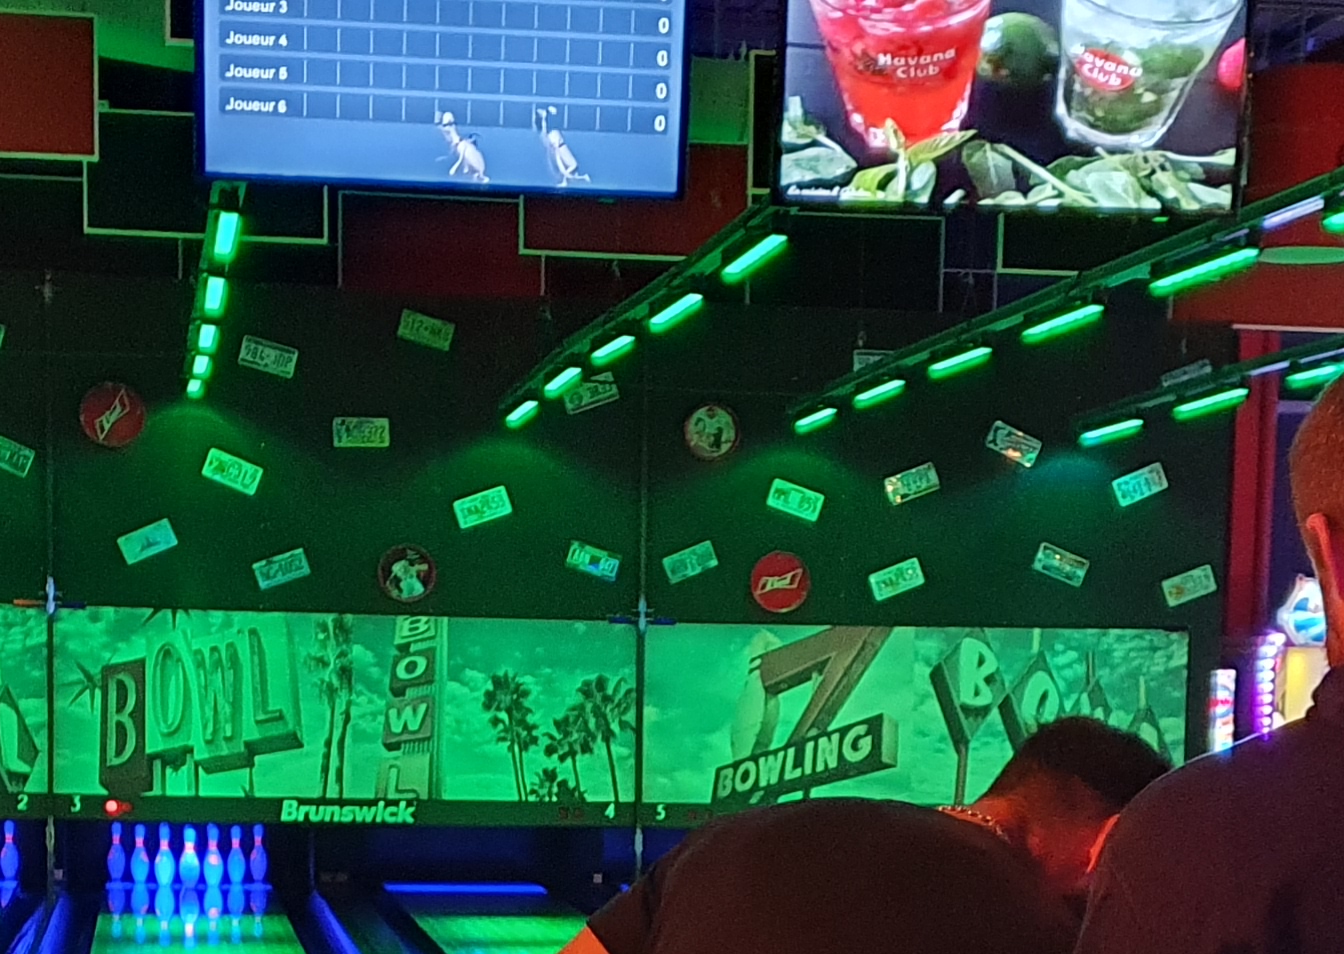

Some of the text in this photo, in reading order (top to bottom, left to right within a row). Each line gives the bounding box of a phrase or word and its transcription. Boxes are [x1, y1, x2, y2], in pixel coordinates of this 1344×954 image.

[224, 0, 669, 34] Joueur 3 0
[224, 30, 668, 67] Joueur 4 0
[877, 48, 956, 66] Havana
[224, 62, 667, 99] Joueur 5 0
[896, 64, 940, 78] Club
[1081, 63, 1122, 86] Club
[224, 96, 666, 132] Joueur 6 0
[106, 625, 284, 768] BOWL
[384, 615, 432, 799] BOWL
[717, 722, 873, 798] BOWLING
[16, 793, 28, 811] 2
[69, 795, 81, 813] 3
[280, 799, 416, 824] Brunswick
[604, 802, 615, 820] 4
[656, 803, 666, 821] 5
